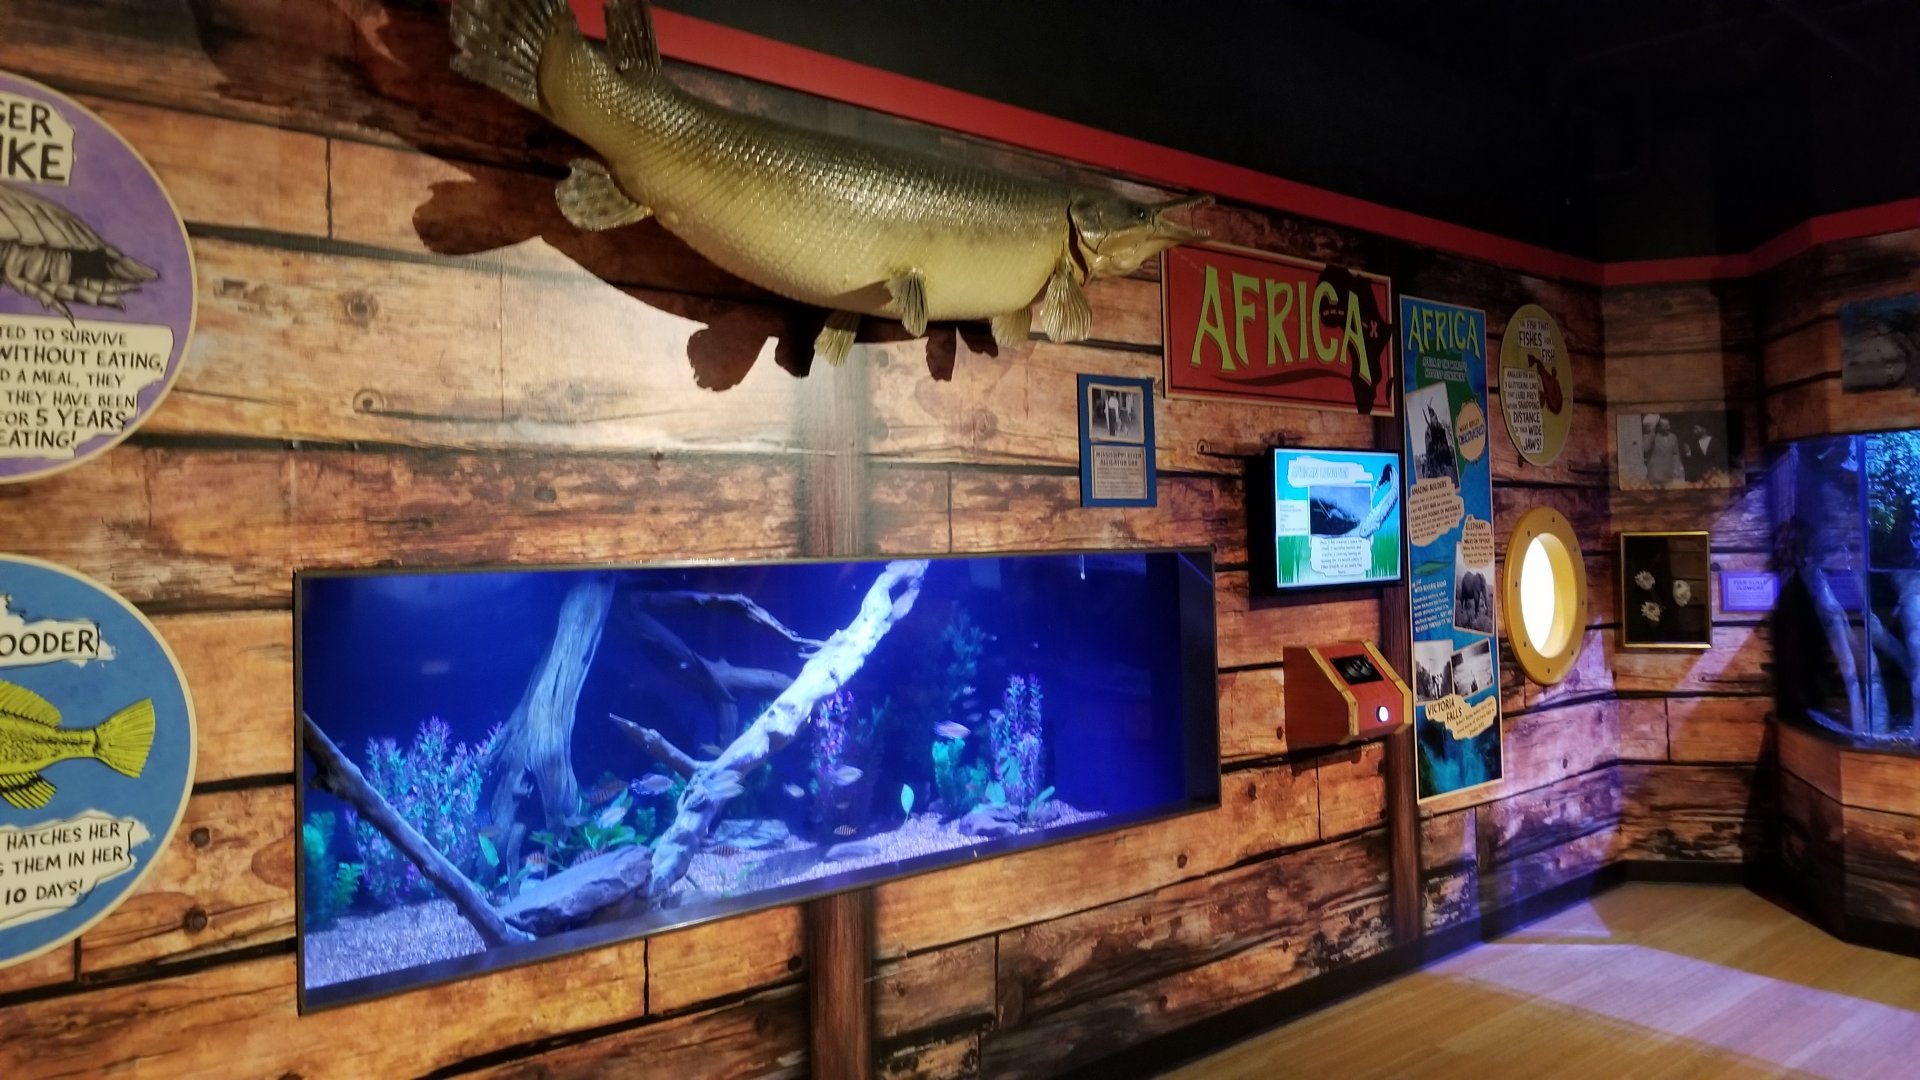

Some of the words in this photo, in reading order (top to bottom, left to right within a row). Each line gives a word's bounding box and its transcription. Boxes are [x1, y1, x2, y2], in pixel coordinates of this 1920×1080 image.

[1190, 264, 1372, 384] AFRICA
[1408, 304, 1481, 359] AFRICA
[32, 326, 55, 342] TO
[61, 328, 127, 347] SURVIVE
[1519, 331, 1543, 347] FISHES
[0, 344, 91, 367] WITHOUT
[96, 351, 164, 373] EATING,
[1541, 349, 1555, 362] FISH
[17, 369, 26, 384] A
[32, 370, 80, 389] MEAL,
[87, 371, 126, 388] THEY
[5, 389, 47, 406] THEY
[53, 390, 91, 407] HAVE
[98, 392, 135, 409] BEEN
[36, 407, 48, 427] 5
[57, 408, 127, 430] YEARS
[1513, 411, 1541, 424] DISTANCE
[1528, 425, 1542, 436] WIDE
[1523, 437, 1542, 451] JAWS!
[0, 629, 95, 657] OODER
[1427, 697, 1456, 717] VICTORIA
[1446, 706, 1463, 724] FALLS
[7, 827, 82, 852] HATCHES
[88, 822, 121, 841] HER
[12, 853, 61, 875] THEM
[68, 850, 85, 868] IN
[92, 846, 124, 865] HER
[5, 886, 27, 906] 10
[36, 877, 83, 901] DAYS!
